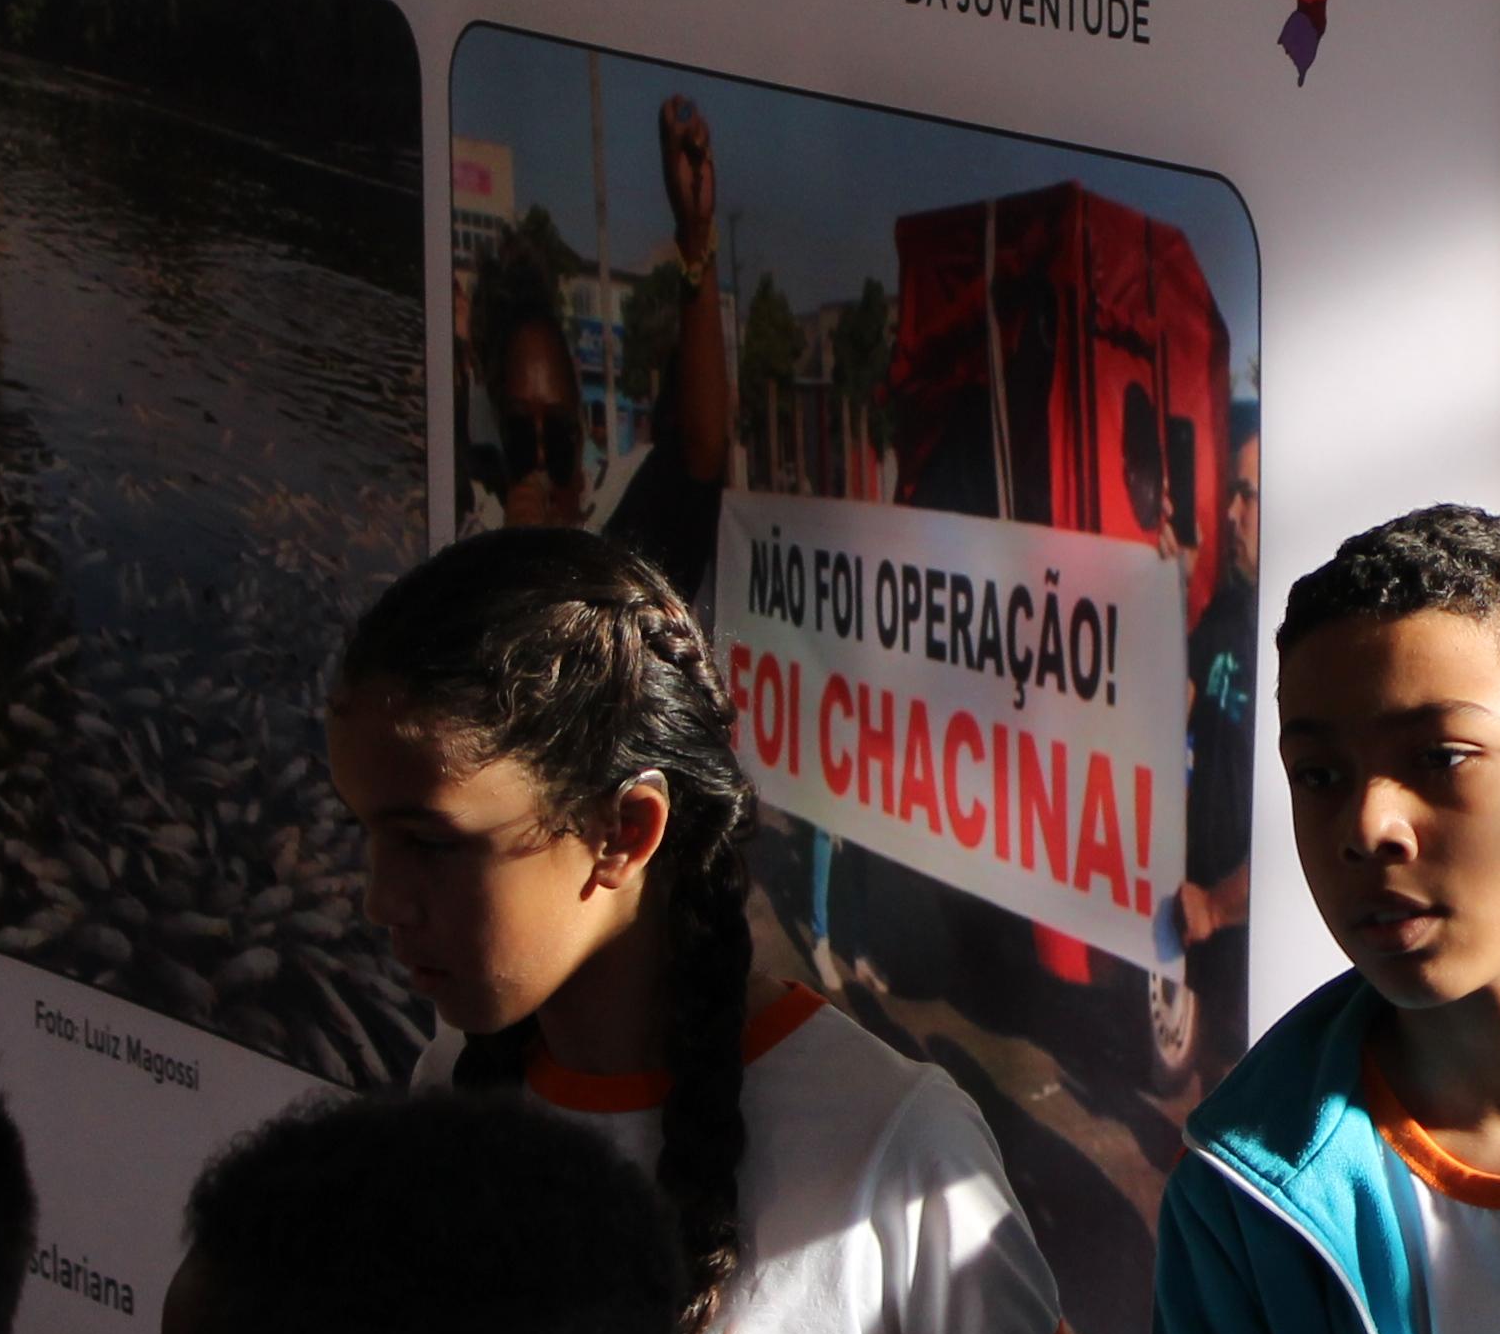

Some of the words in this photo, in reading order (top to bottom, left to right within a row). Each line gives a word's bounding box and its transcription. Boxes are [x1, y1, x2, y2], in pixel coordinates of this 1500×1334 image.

[749, 525, 806, 628] NÃO
[813, 548, 864, 642] FOI
[876, 558, 1118, 710] OPERAÇÃO!
[729, 643, 801, 776] FOI
[819, 672, 1153, 917] CHACINA!
[34, 999, 80, 1045] Foto:
[84, 1018, 121, 1061] Luiz
[126, 1032, 200, 1092] Magossi
